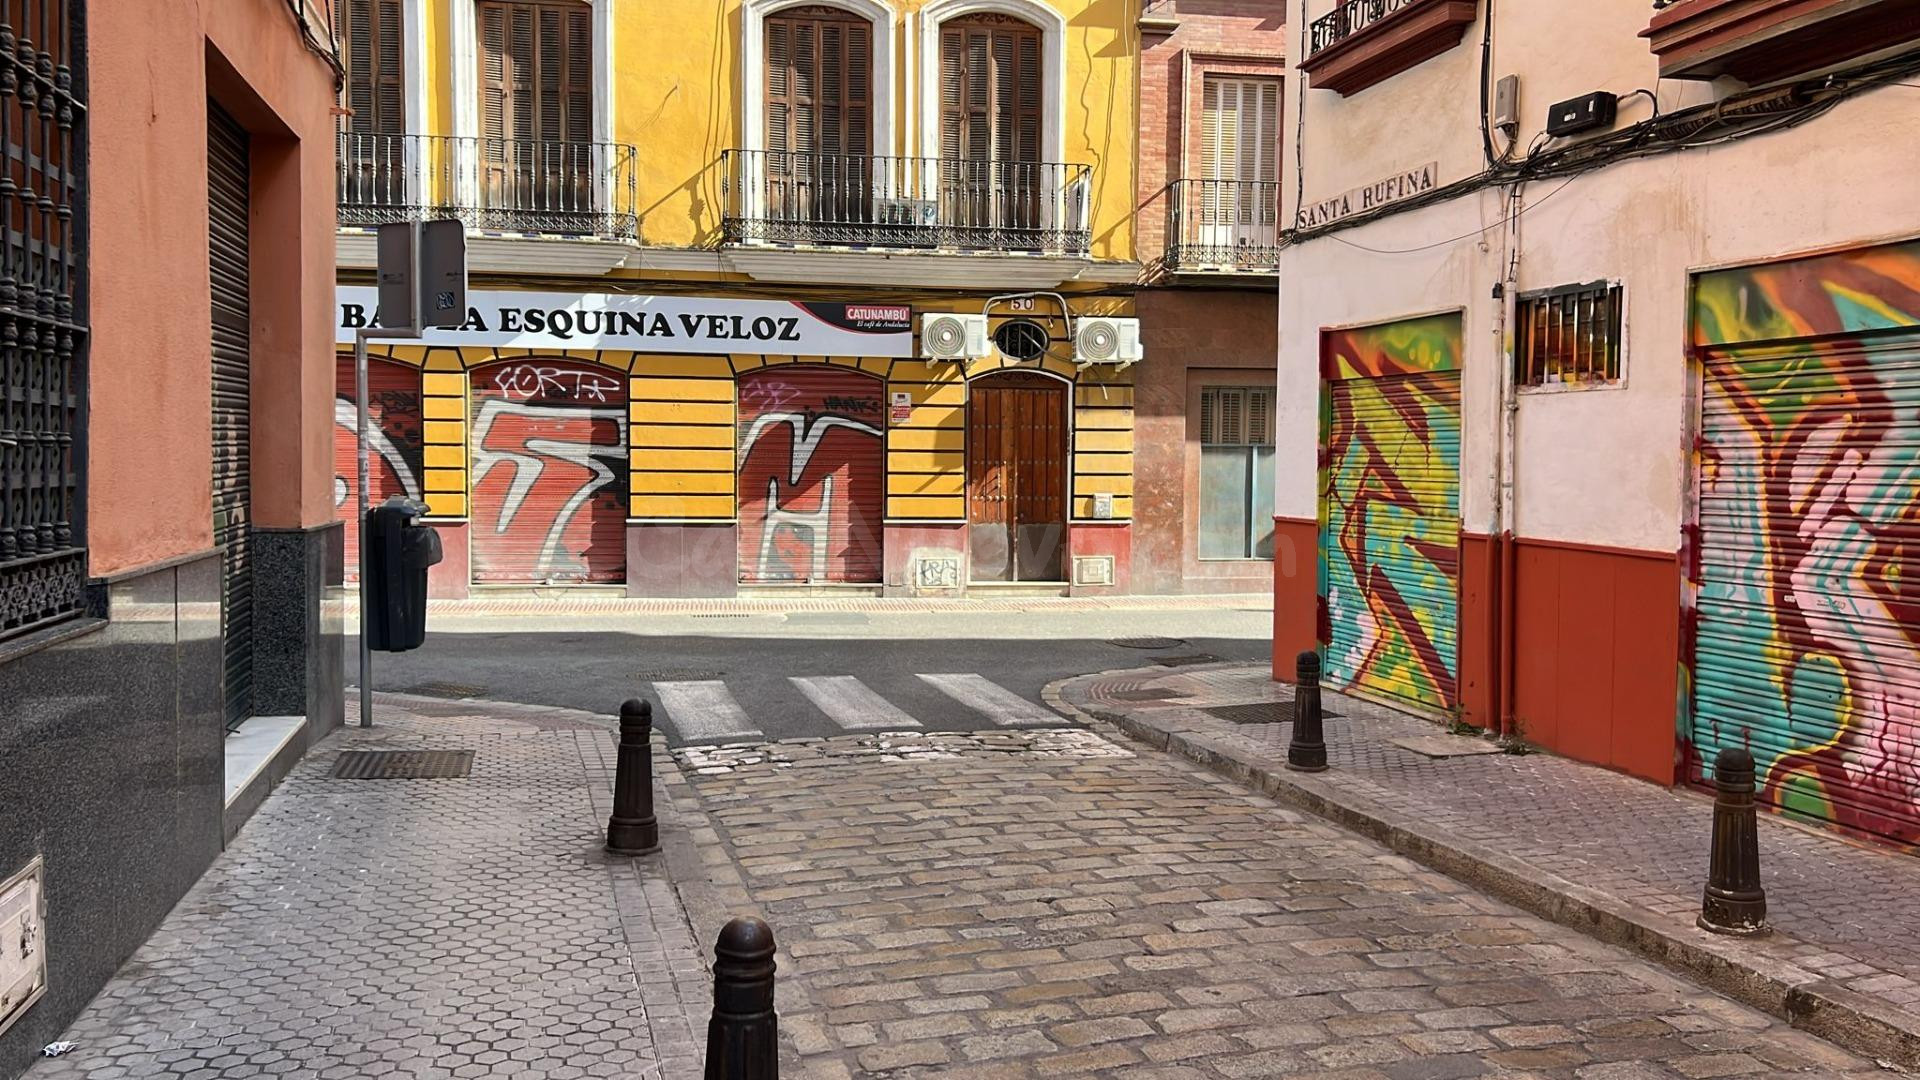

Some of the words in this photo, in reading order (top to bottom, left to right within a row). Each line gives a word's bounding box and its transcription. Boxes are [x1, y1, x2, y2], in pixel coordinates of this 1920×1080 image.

[1299, 195, 1351, 229] SANTA
[1363, 167, 1432, 209] RUFINA
[1013, 298, 1033, 310] 50
[498, 308, 674, 339] ESQUINA
[678, 314, 801, 341] VELOZ
